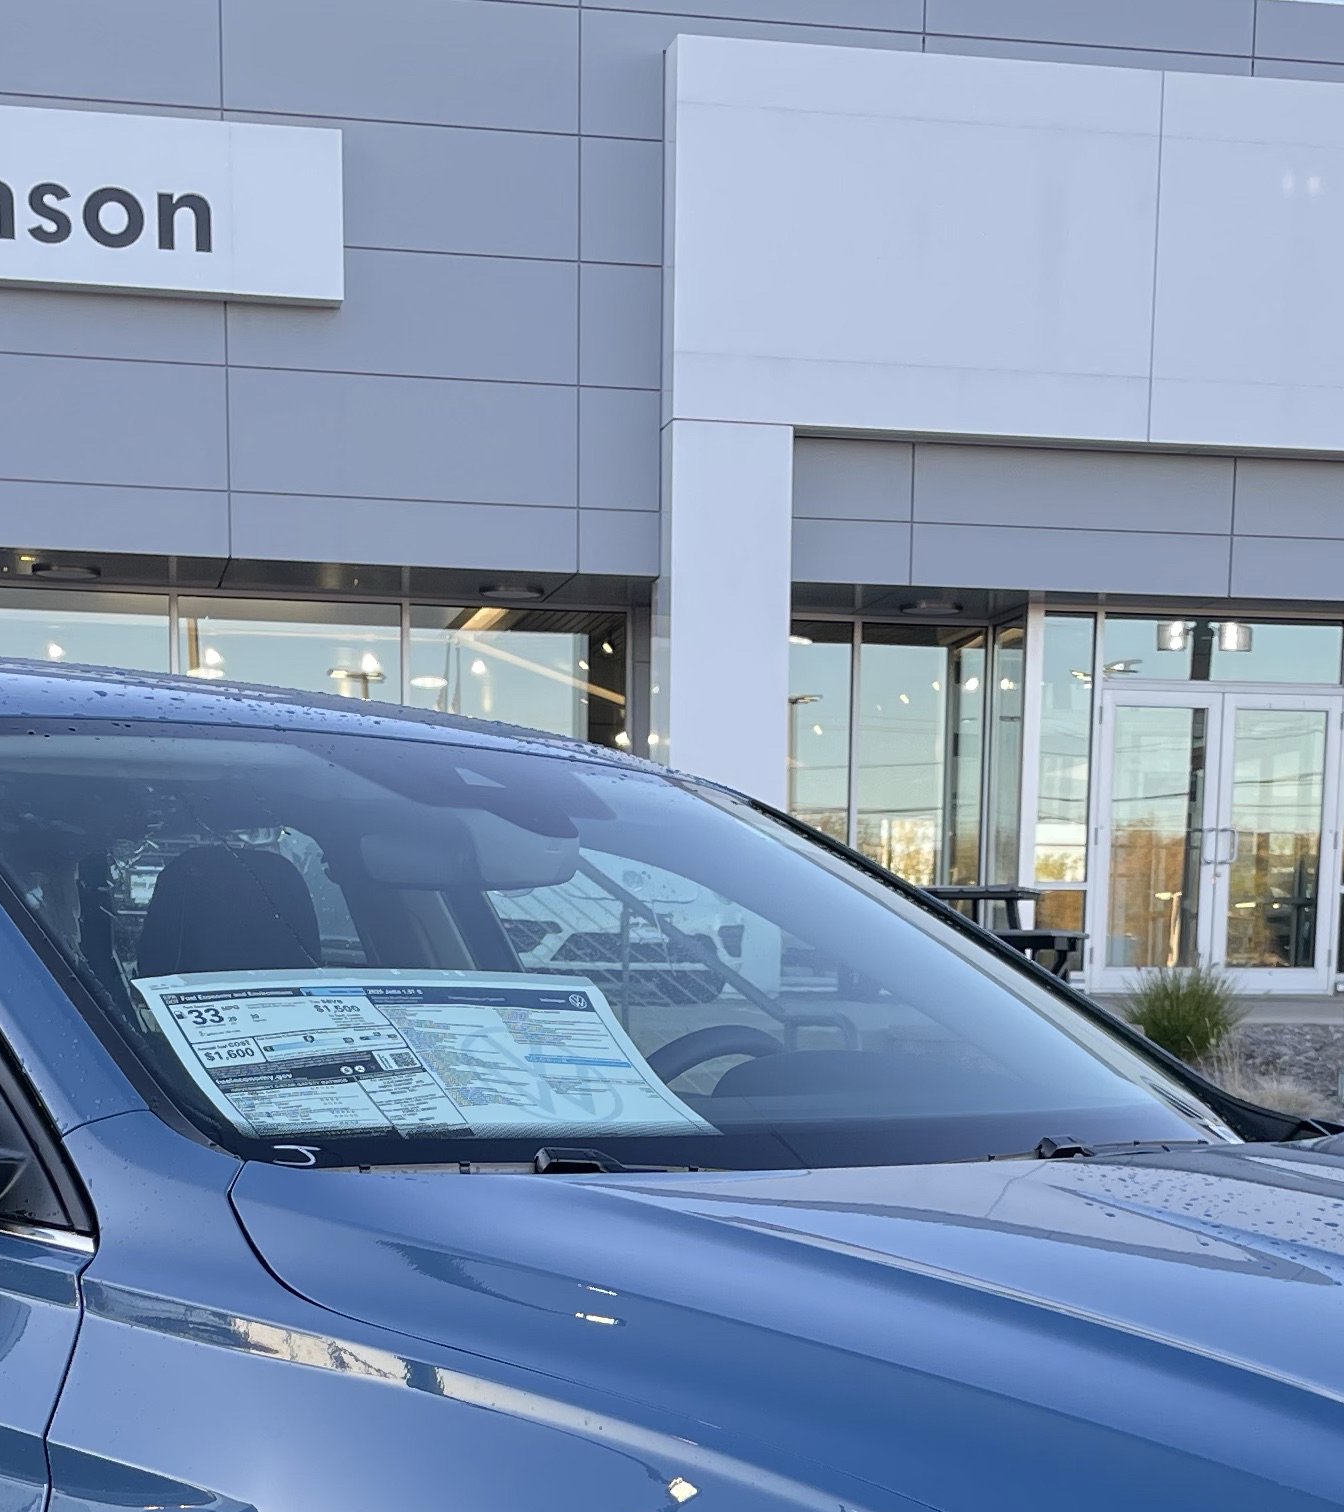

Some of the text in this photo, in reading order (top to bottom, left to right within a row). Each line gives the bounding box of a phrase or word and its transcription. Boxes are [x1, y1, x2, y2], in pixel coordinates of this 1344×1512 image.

[313, 1004, 361, 1014] $1,500
[188, 1008, 225, 1025] 33
[204, 1047, 255, 1061] $1,600
